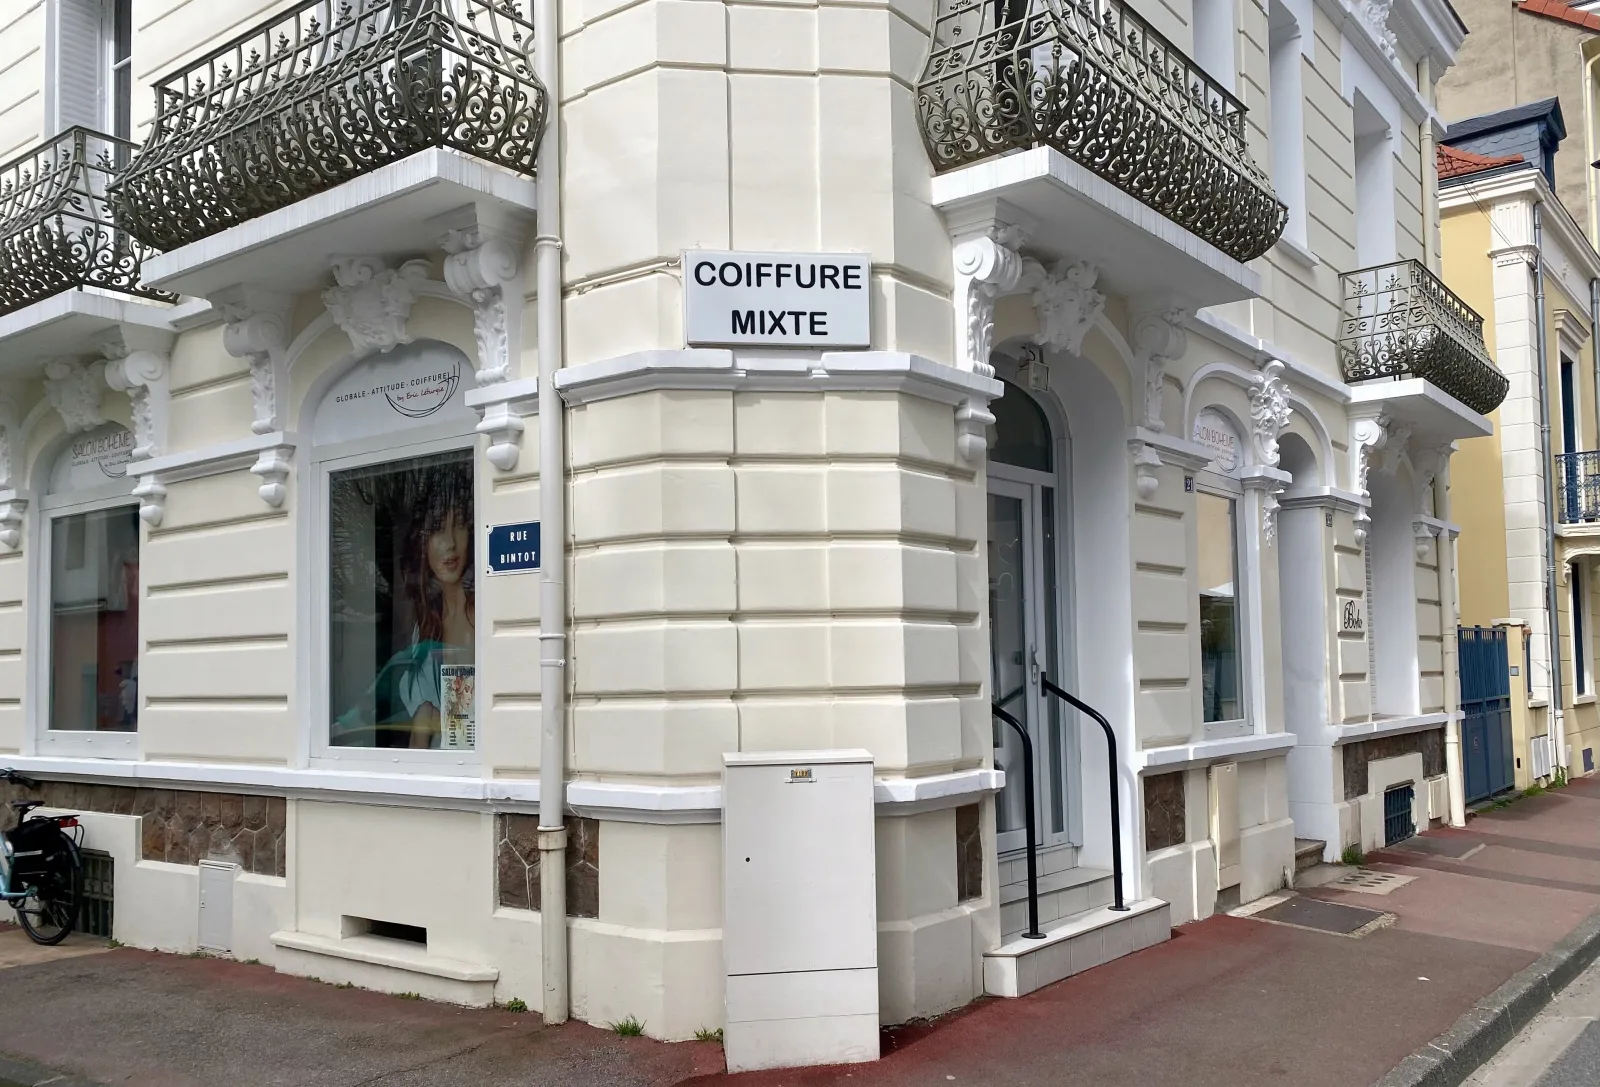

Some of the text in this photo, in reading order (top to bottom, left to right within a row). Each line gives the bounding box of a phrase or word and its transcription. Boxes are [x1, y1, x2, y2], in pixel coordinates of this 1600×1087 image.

[694, 261, 862, 290] COIFFURE
[731, 309, 828, 336] MIXTE
[335, 372, 448, 403] GLOBALE ATTITUDE COIFFURE
[406, 391, 420, 400] Eric
[72, 439, 97, 460] SALON
[1186, 478, 1193, 491] 21
[510, 531, 527, 541] RUE
[501, 552, 535, 563] BINTOT
